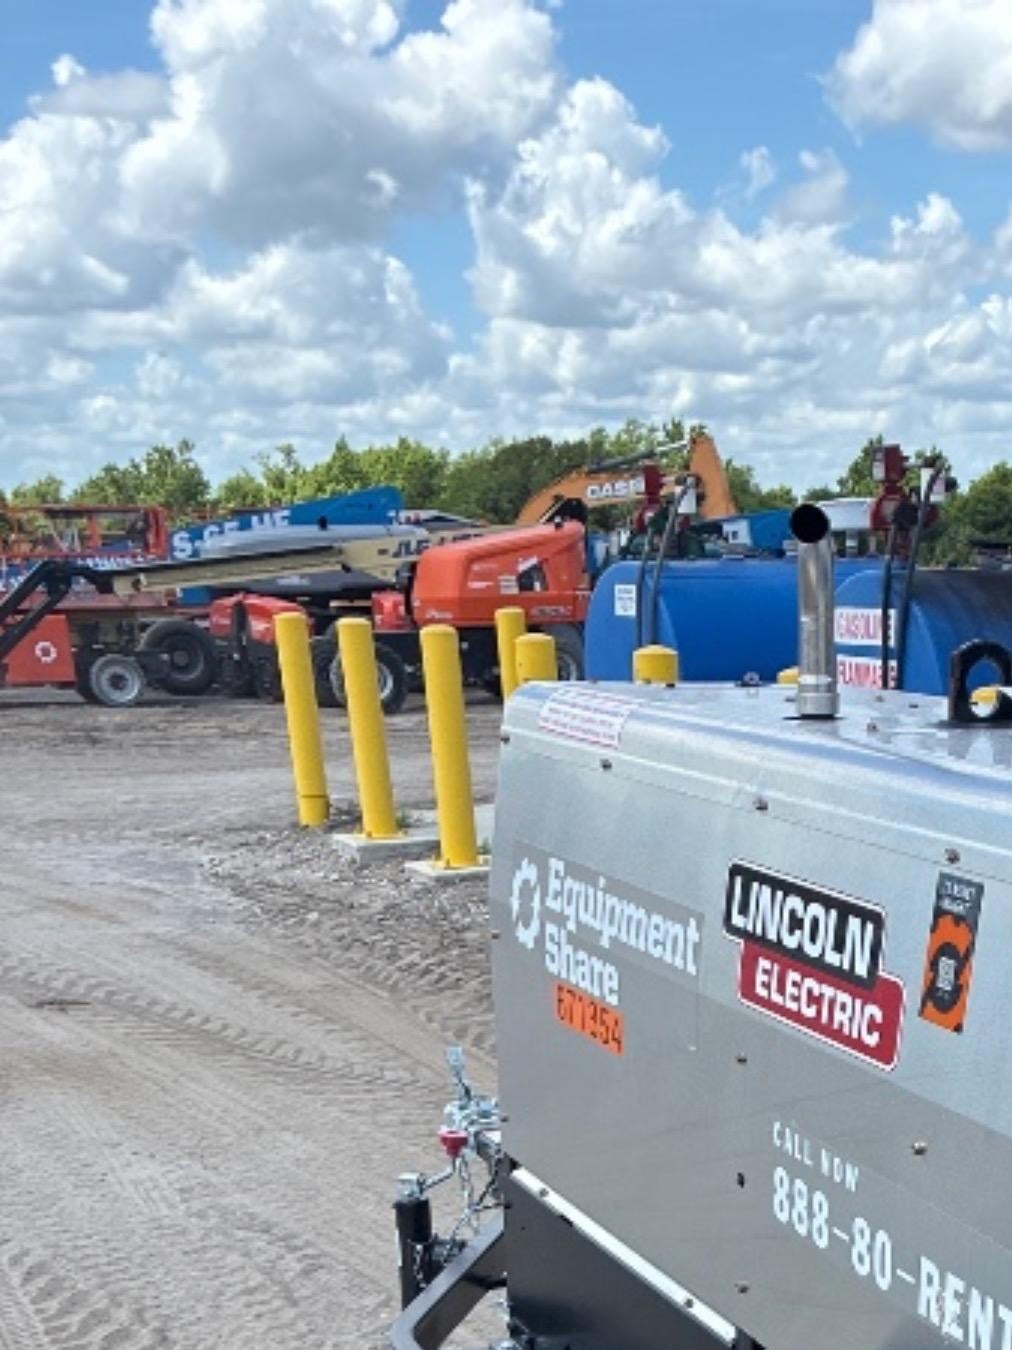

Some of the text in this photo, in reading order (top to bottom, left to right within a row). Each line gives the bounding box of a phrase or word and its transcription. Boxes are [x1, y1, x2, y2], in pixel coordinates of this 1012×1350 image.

[545, 857, 700, 976] Equipment
[731, 874, 875, 979] LINCOLN
[545, 921, 619, 1006] Share
[753, 957, 884, 1048] ELECTRIC
[557, 983, 622, 1054] 671354
[773, 1121, 859, 1193] CALL NOW
